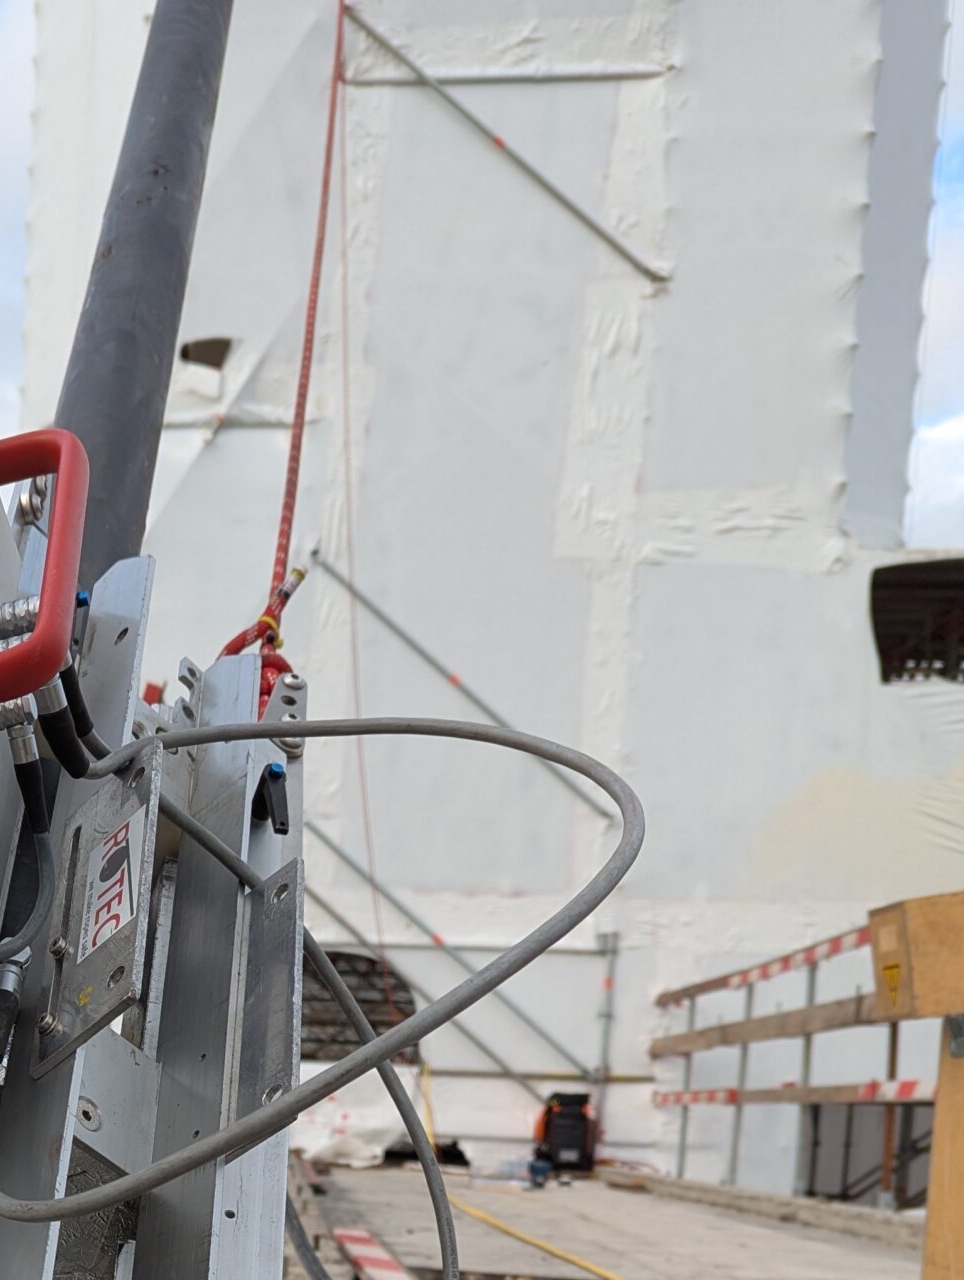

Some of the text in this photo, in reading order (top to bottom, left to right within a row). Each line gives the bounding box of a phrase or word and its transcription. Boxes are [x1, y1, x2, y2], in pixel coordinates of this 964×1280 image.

[85, 889, 94, 917] make
[80, 914, 90, 942] ropes
[79, 936, 89, 961] safe
